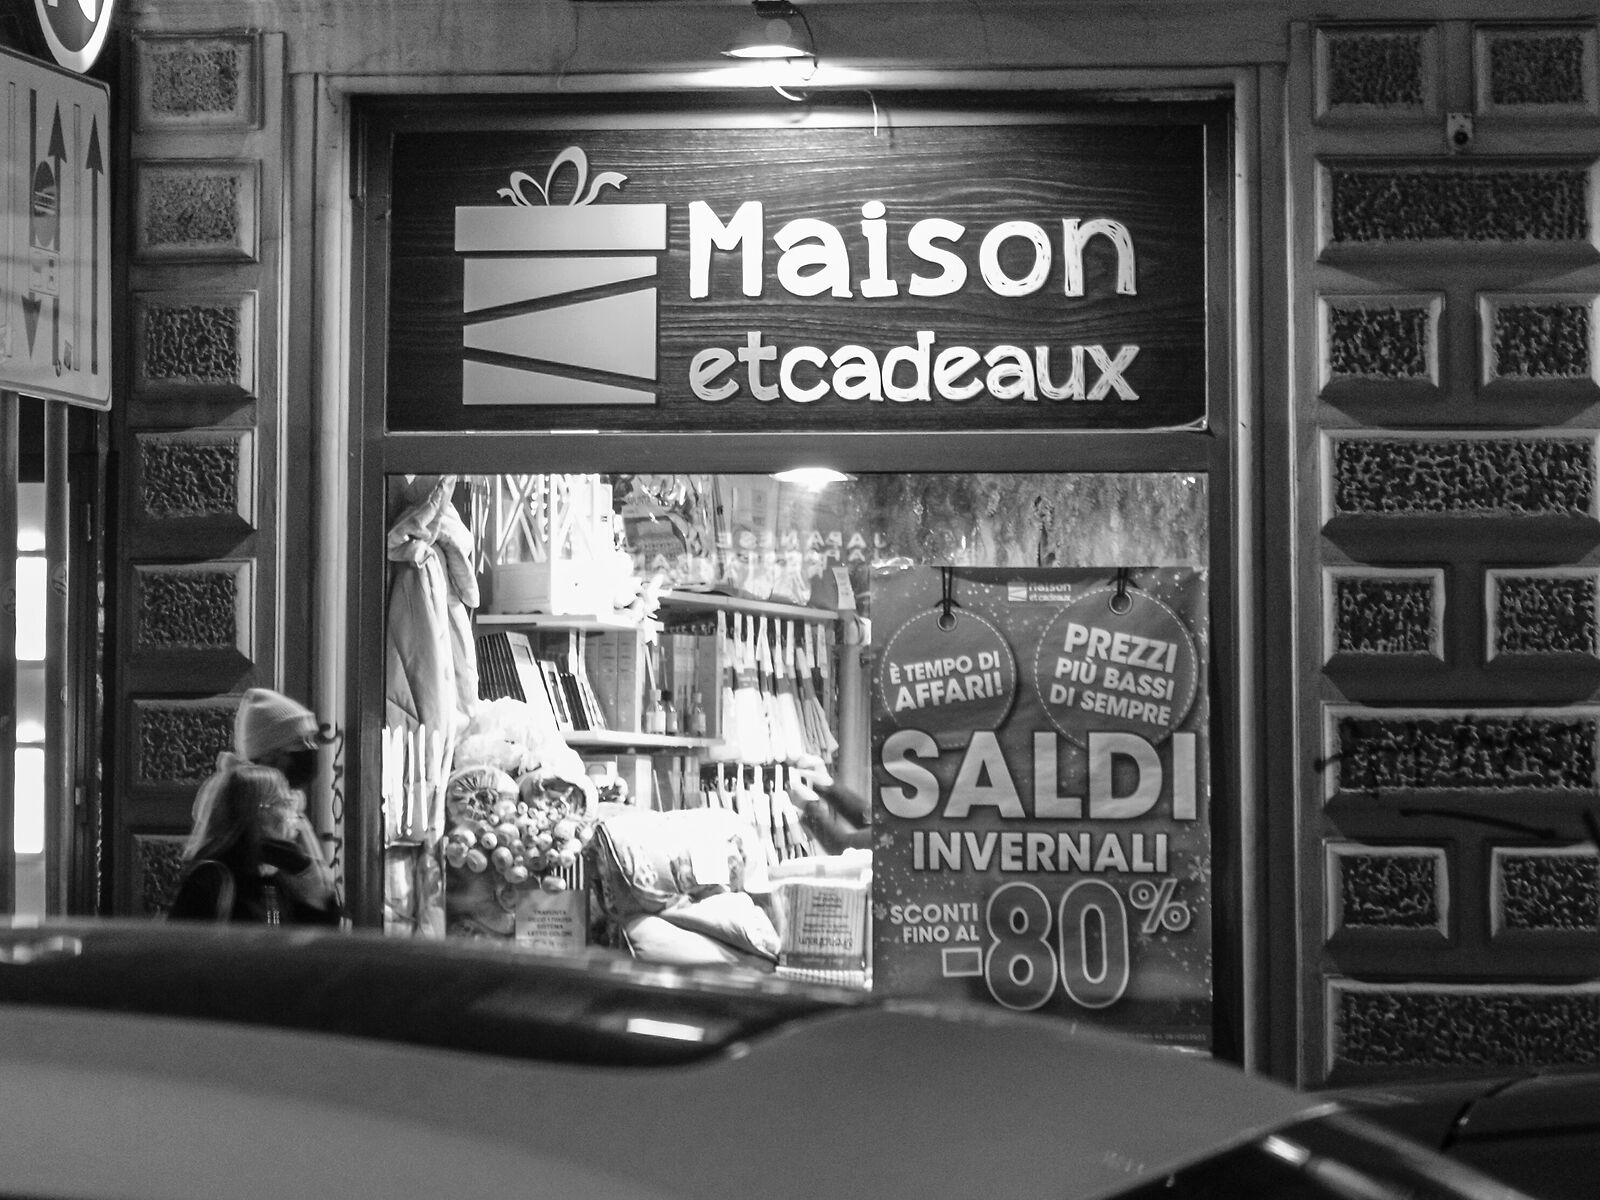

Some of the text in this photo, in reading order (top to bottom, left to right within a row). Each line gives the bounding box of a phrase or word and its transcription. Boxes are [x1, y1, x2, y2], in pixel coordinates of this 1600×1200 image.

[688, 200, 1137, 299] Maison
[889, 650, 1001, 685] È TEMPO DI
[1063, 623, 1178, 673] PREZZI
[896, 672, 1003, 712] AFFARI!
[1055, 654, 1174, 701] PIÙ BASSI
[1049, 683, 1171, 726] DI SEMPRE
[880, 728, 1198, 821] SALDI
[912, 831, 1168, 872] INVERNALI
[890, 903, 979, 925] SCONTI
[903, 925, 980, 943] FINO AL
